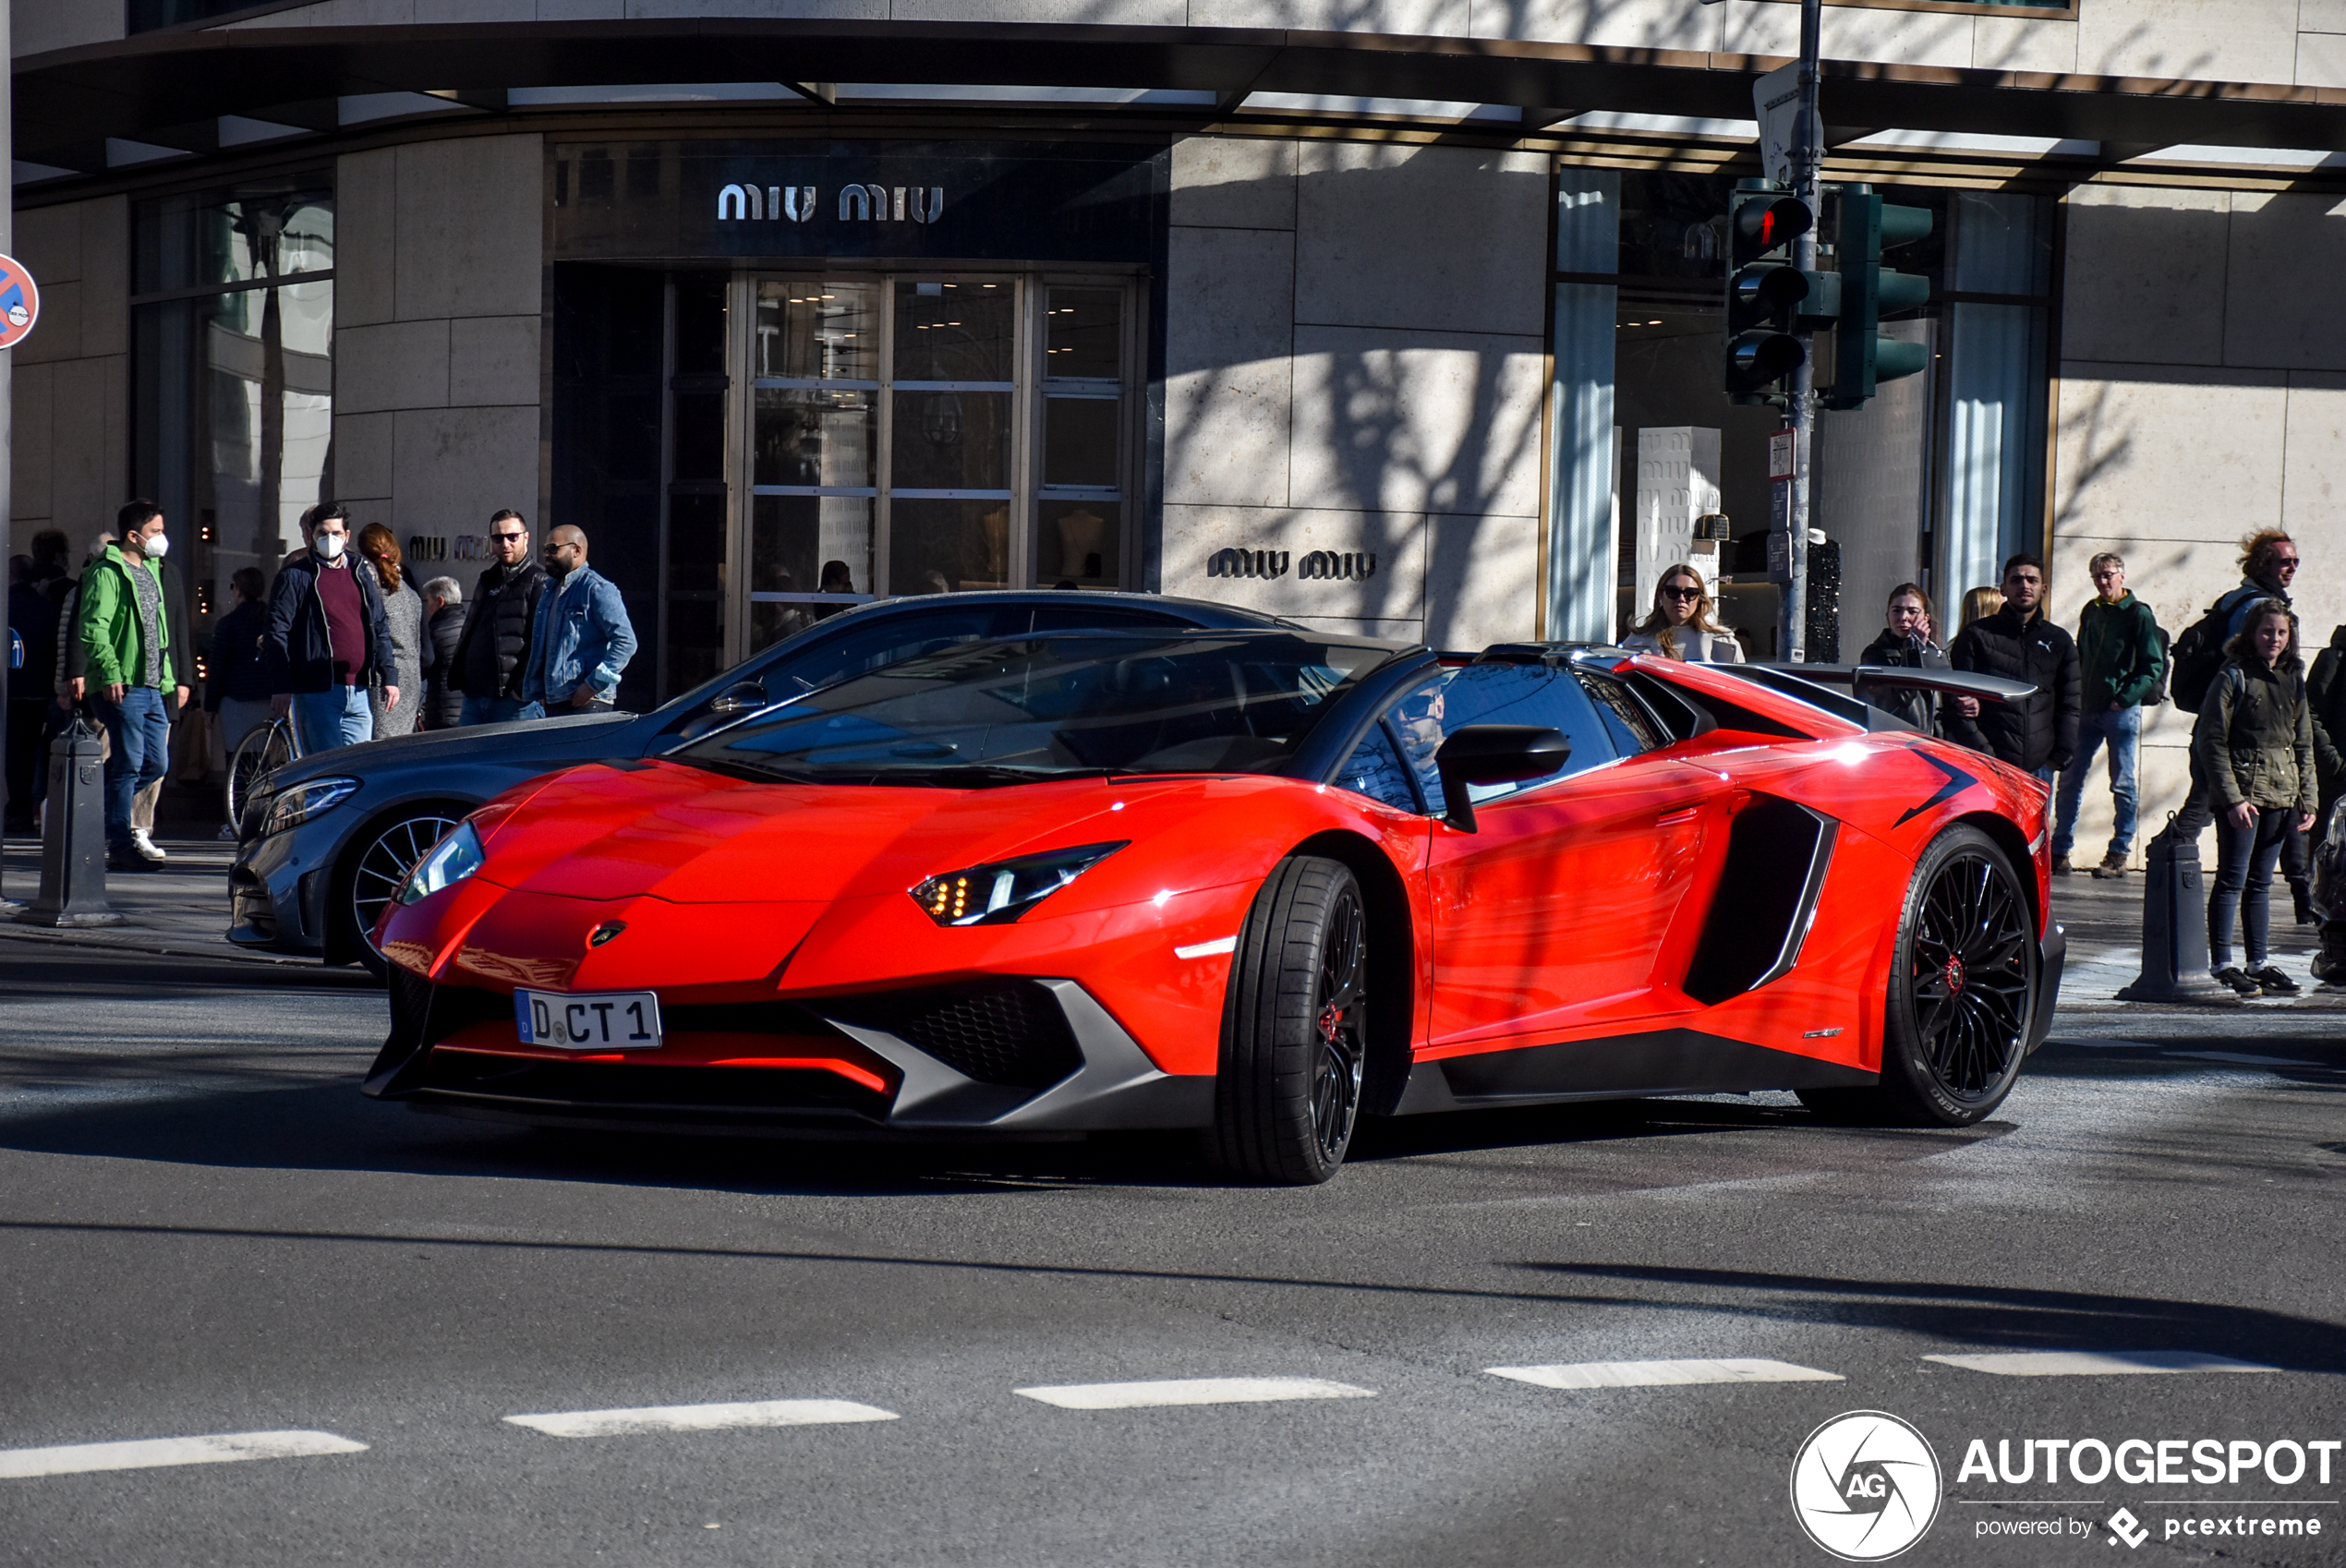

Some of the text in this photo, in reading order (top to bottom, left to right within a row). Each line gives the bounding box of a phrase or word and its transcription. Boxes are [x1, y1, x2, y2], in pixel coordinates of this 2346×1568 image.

[532, 999, 651, 1043] D CT 1
[1930, 1088, 1962, 1116] ZERO
